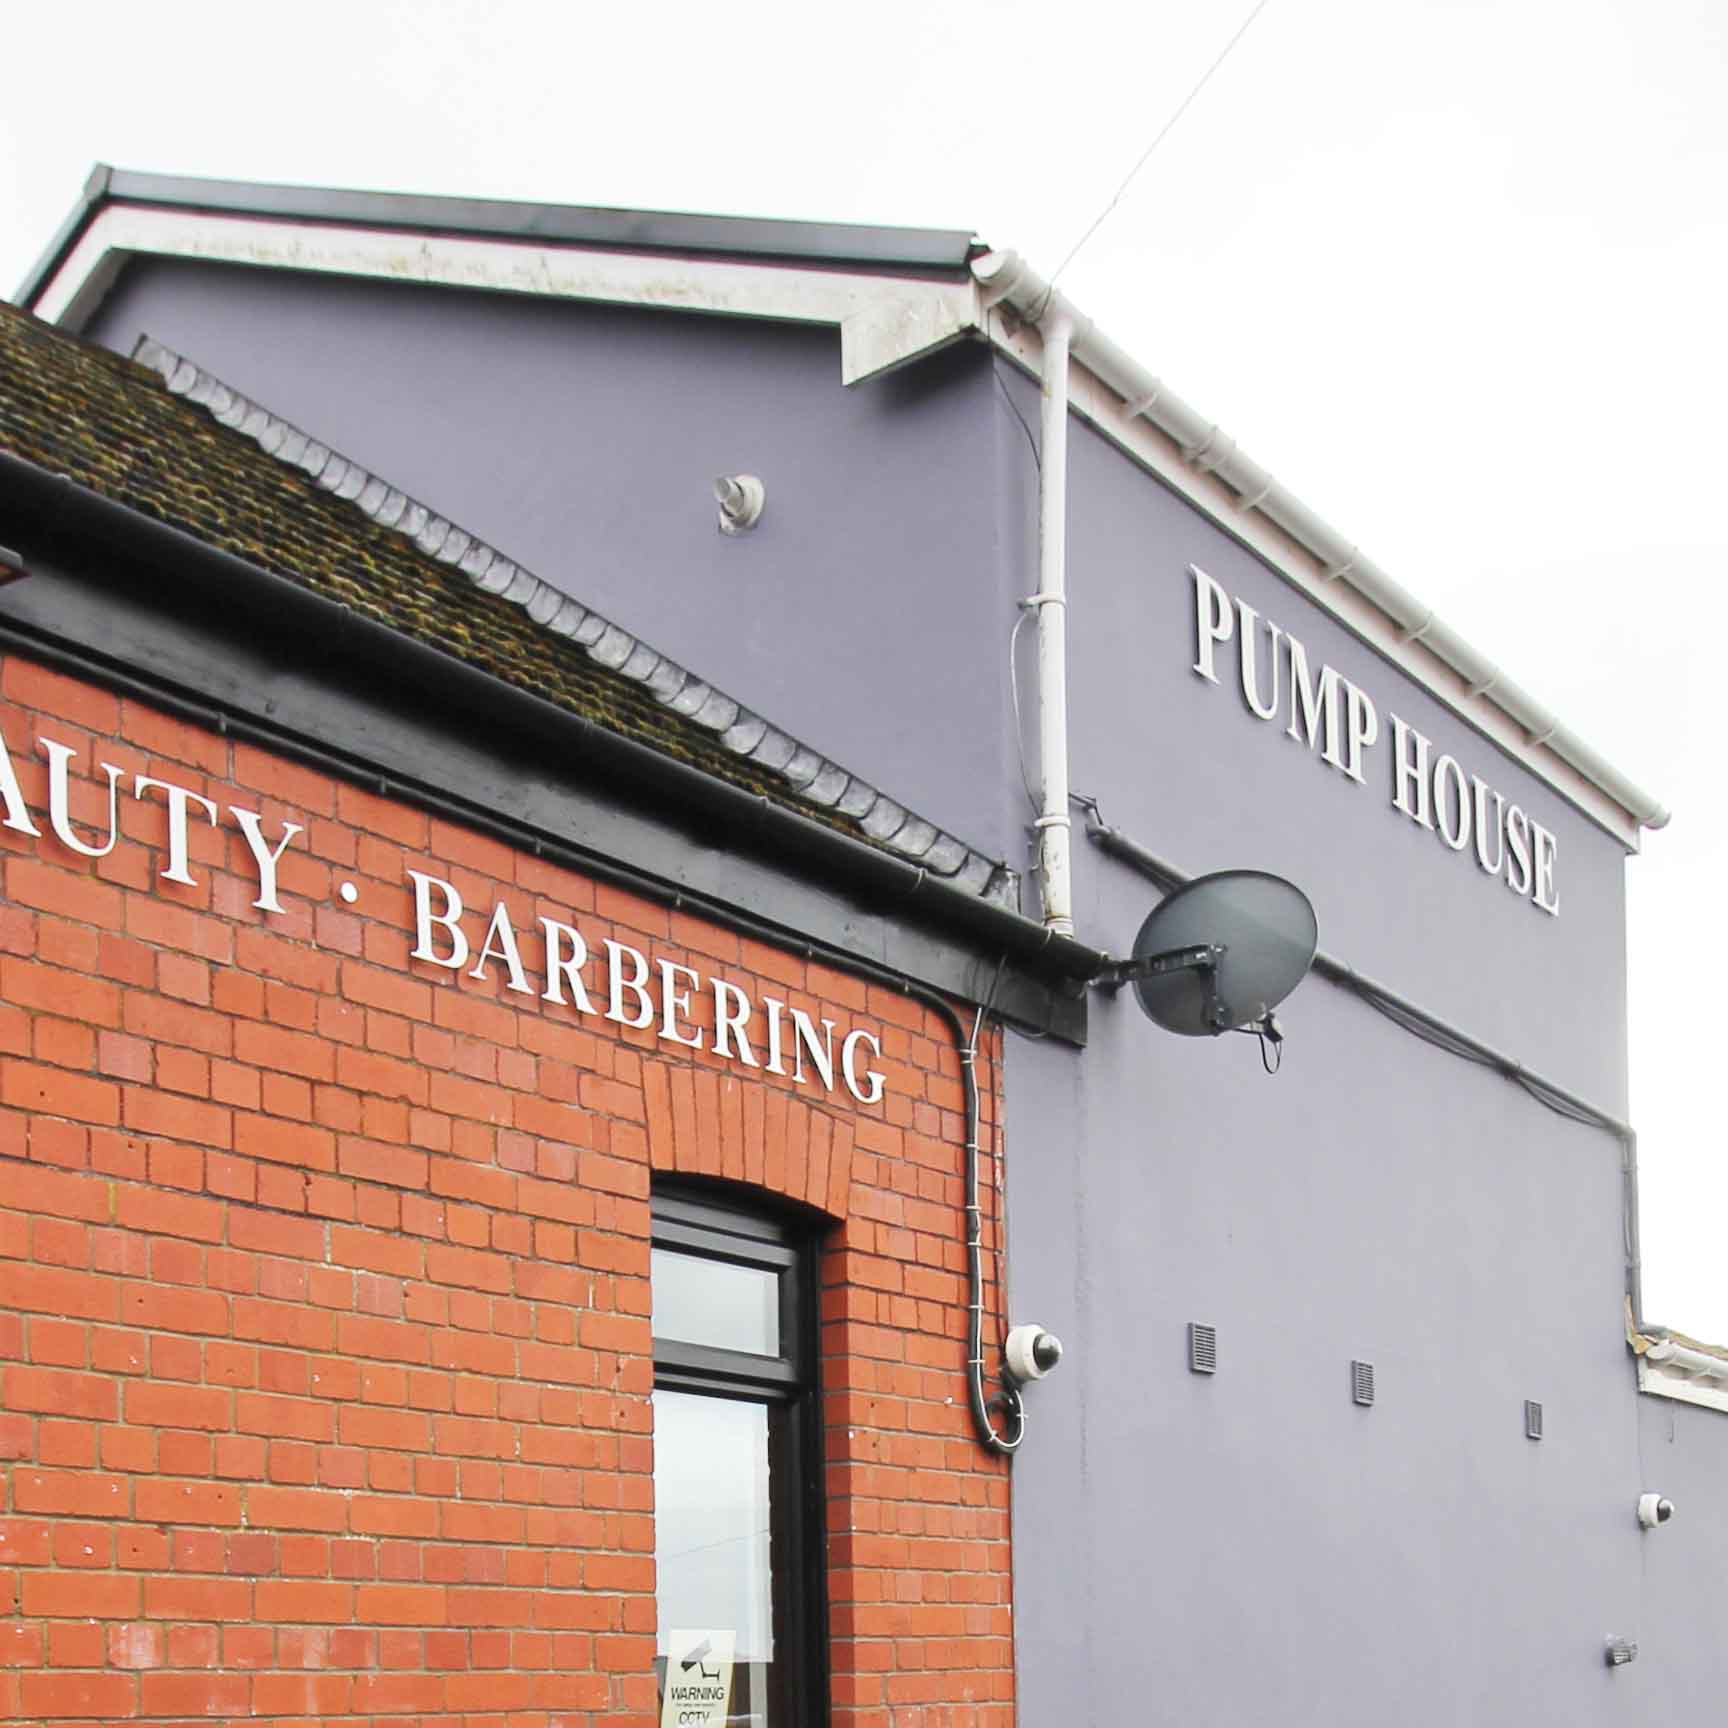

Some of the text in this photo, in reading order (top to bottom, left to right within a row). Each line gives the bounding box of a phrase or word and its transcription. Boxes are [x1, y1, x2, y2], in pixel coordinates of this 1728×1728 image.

[1189, 561, 1559, 917] PUMP HOUSE
[407, 869, 886, 1104] BARBERING
[671, 1686, 725, 1700] WARNING
[678, 1711, 711, 1725] CCTV
